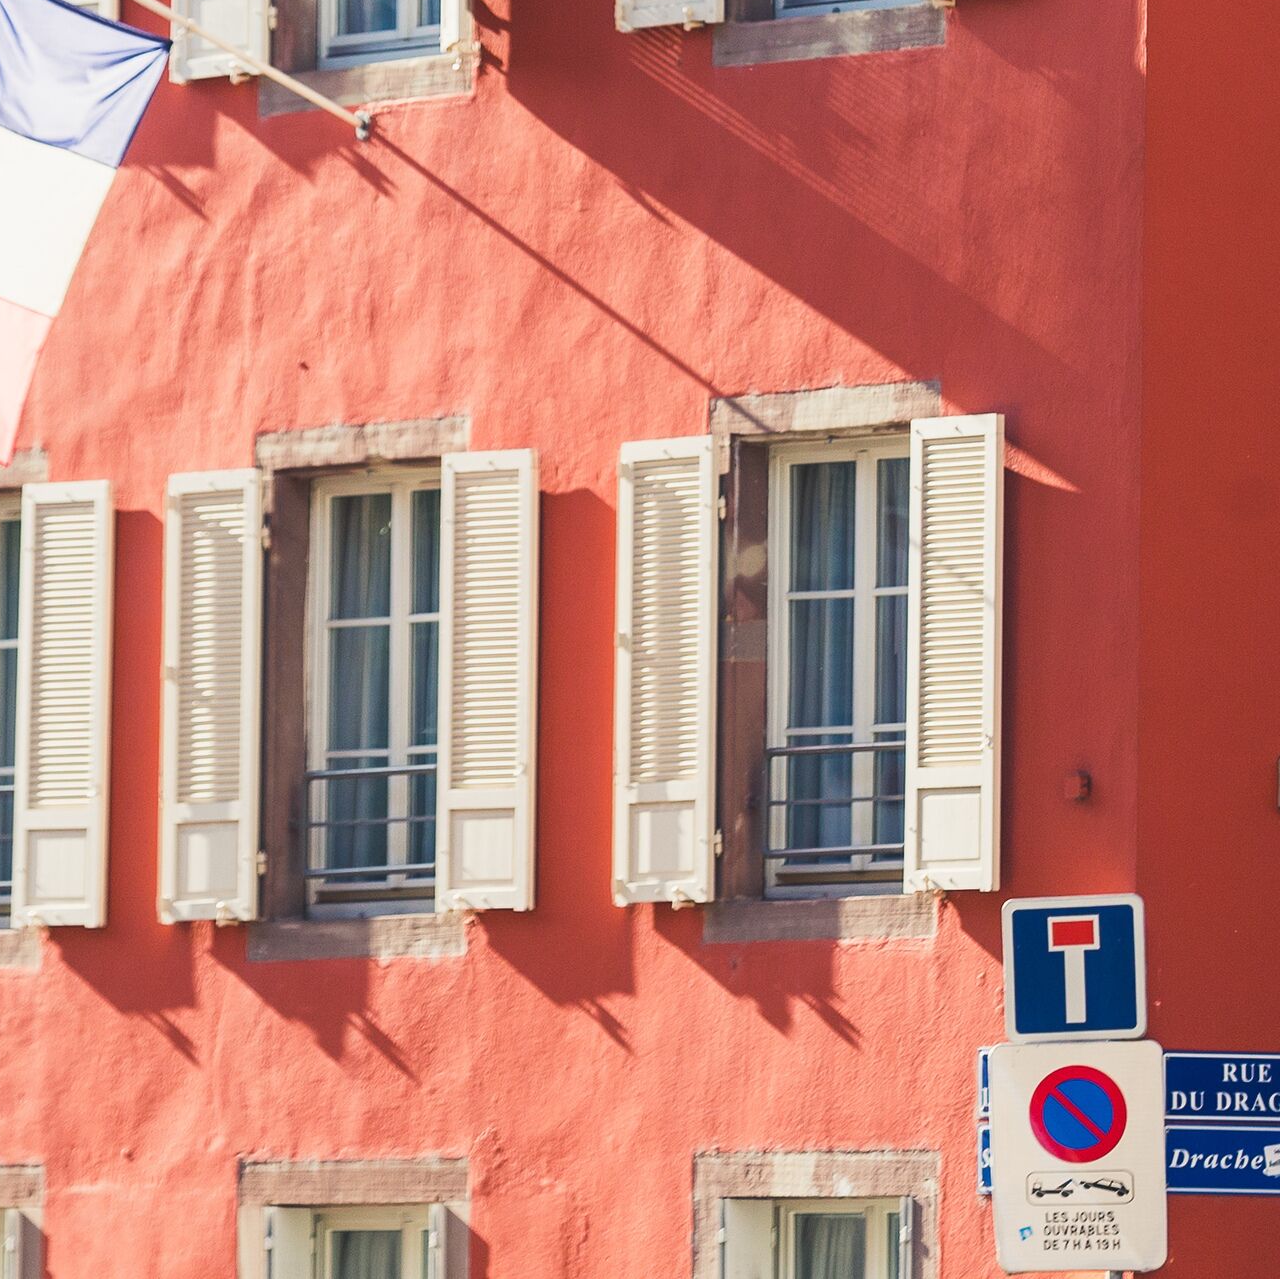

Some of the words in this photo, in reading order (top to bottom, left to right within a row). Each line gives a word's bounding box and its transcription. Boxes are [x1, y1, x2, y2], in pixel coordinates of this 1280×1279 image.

[1222, 1063, 1272, 1083] RUE
[1171, 1090, 1205, 1111] DU
[1045, 1211, 1068, 1223] LES
[1071, 1211, 1115, 1222] JOURS
[1043, 1224, 1119, 1236] OUVRABLES
[1043, 1239, 1059, 1250] DE
[1063, 1239, 1070, 1250] 7
[1073, 1239, 1081, 1250] H
[1096, 1239, 1109, 1250] 19
[1112, 1239, 1120, 1250] H
